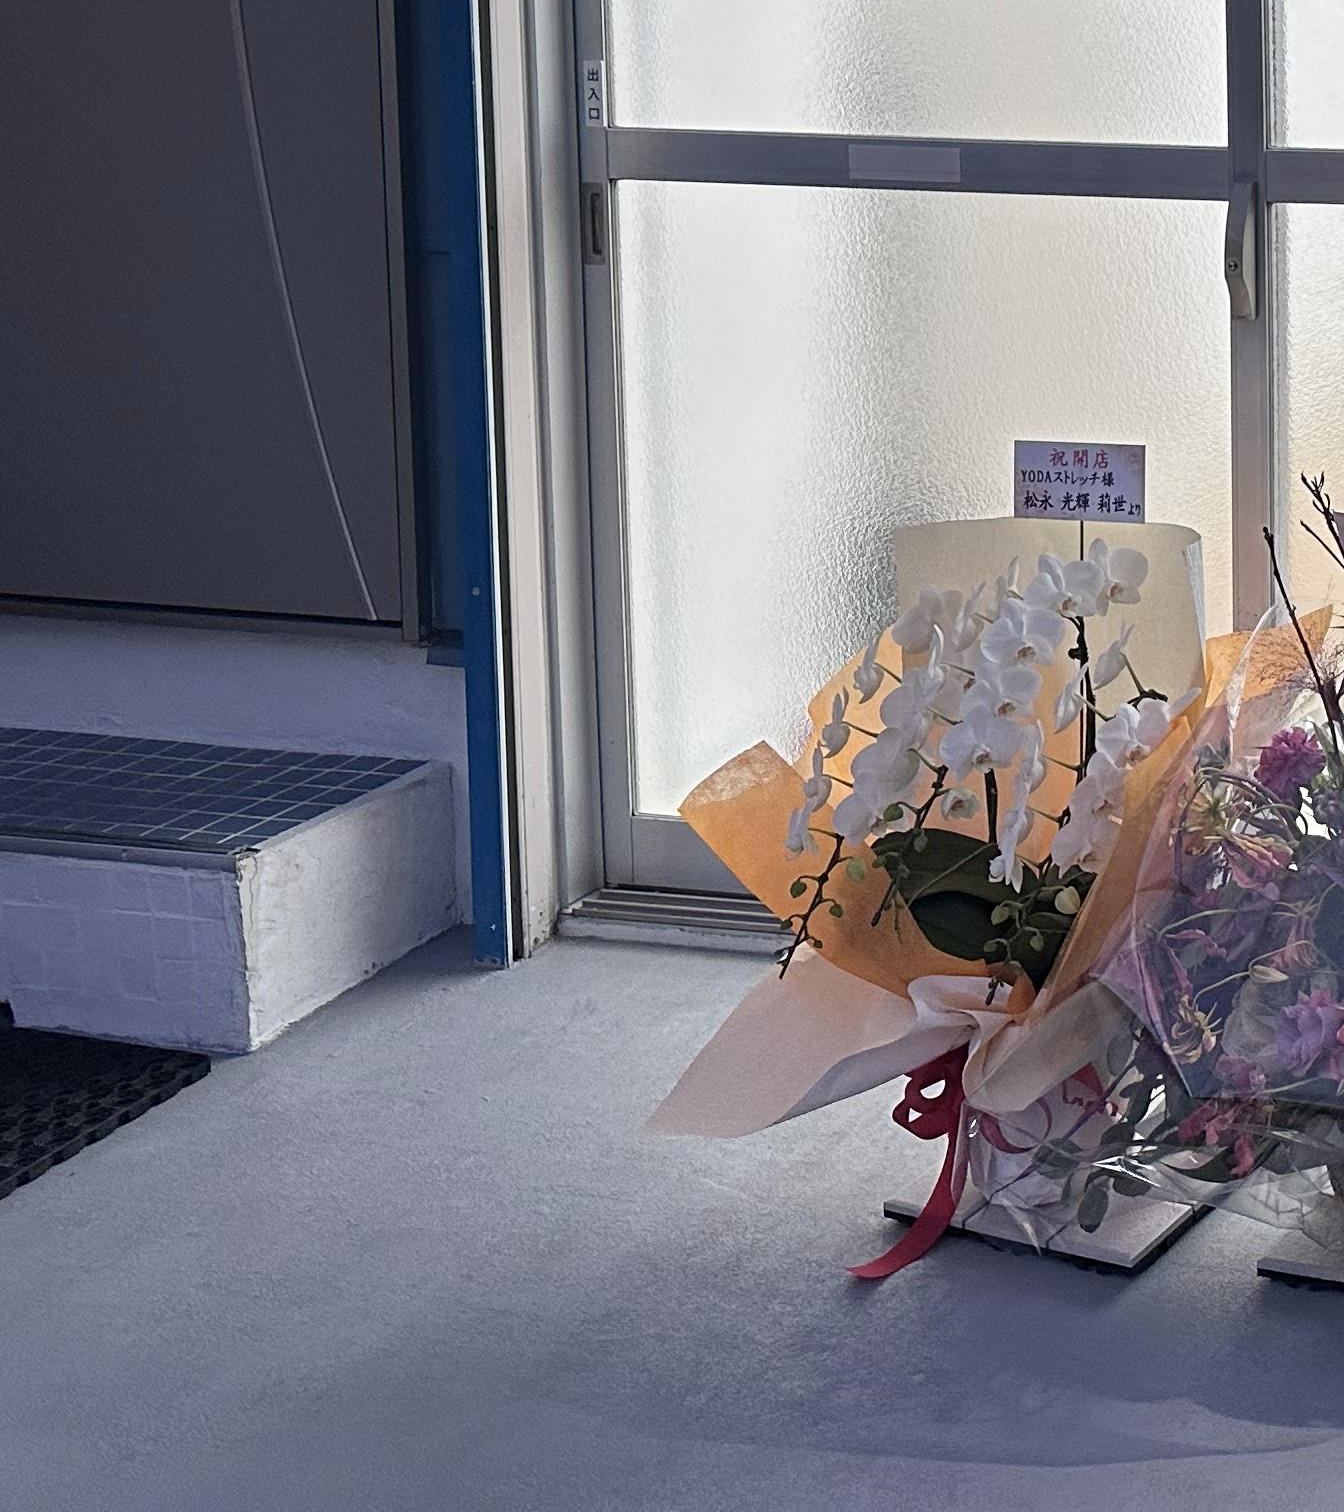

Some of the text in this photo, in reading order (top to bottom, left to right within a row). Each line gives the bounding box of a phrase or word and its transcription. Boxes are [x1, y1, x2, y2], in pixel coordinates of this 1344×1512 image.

[587, 67, 601, 120] 出入口
[1021, 469, 1115, 487] YODAストレッチ様
